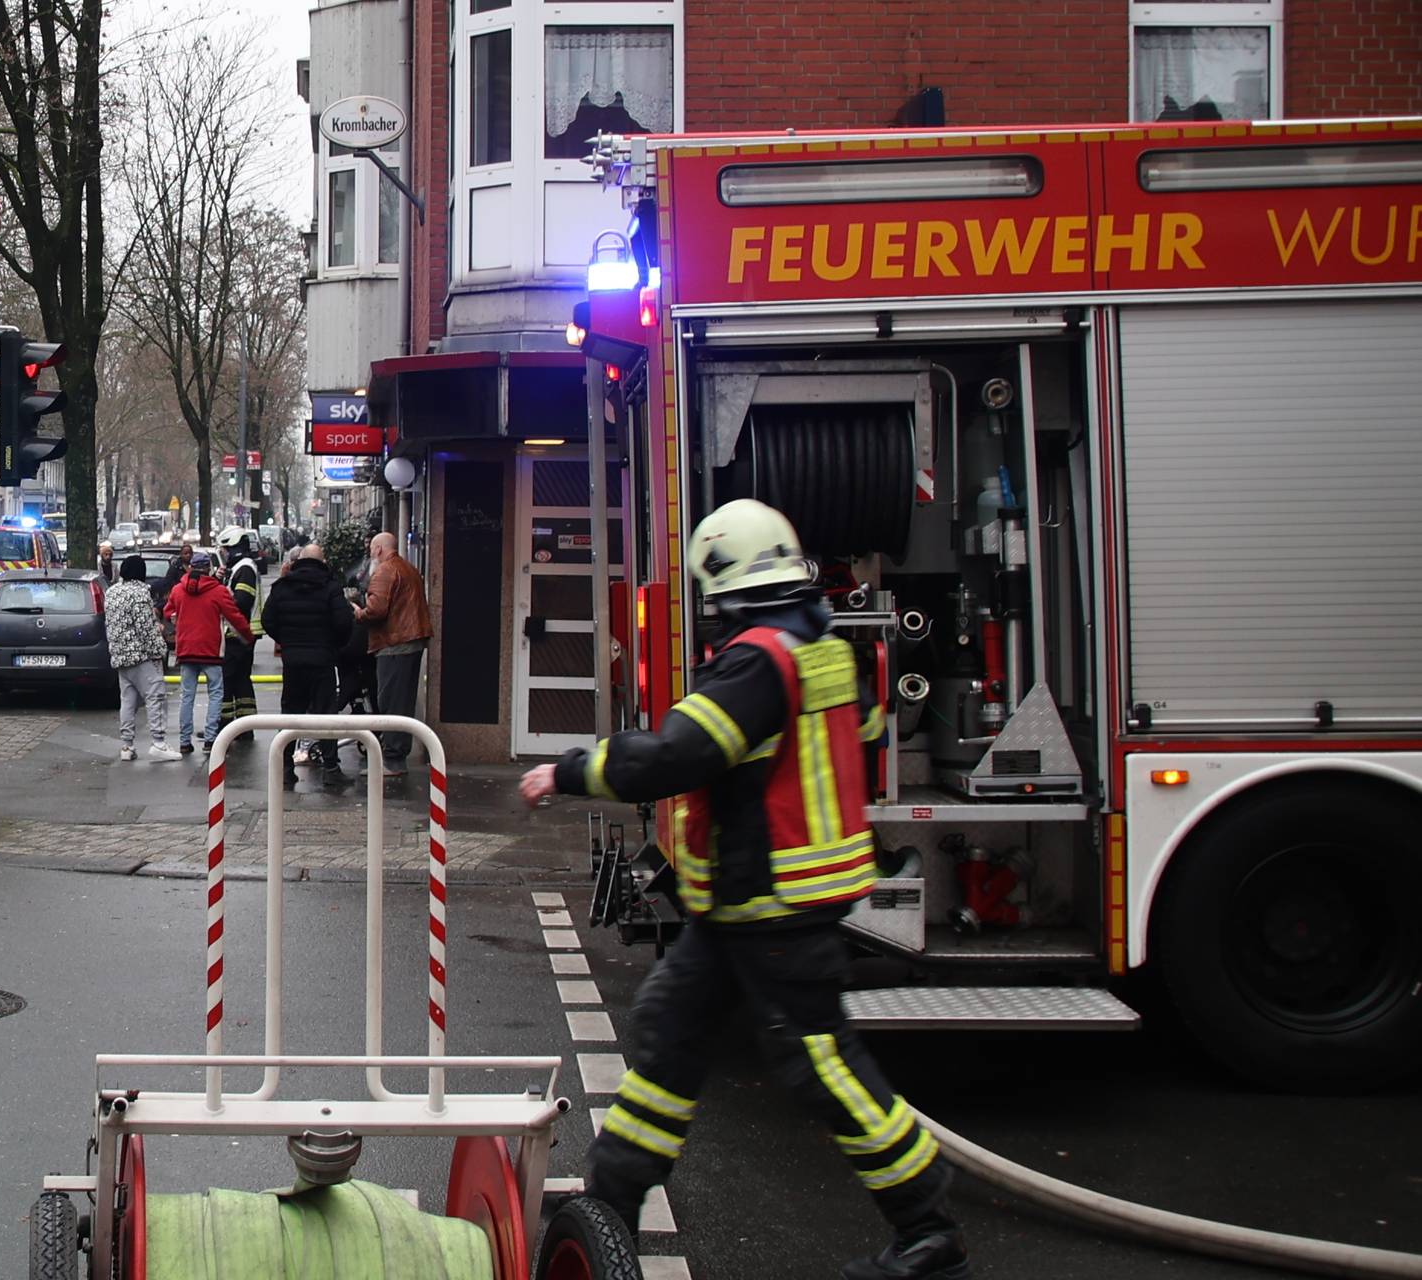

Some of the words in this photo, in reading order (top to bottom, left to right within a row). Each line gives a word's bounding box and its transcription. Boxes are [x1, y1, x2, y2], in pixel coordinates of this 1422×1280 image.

[332, 116, 397, 132] Krombacher
[726, 212, 1207, 284] FEUERWEHR
[329, 400, 365, 423] sky
[325, 433, 368, 447] sport
[1153, 701, 1167, 709] G4
